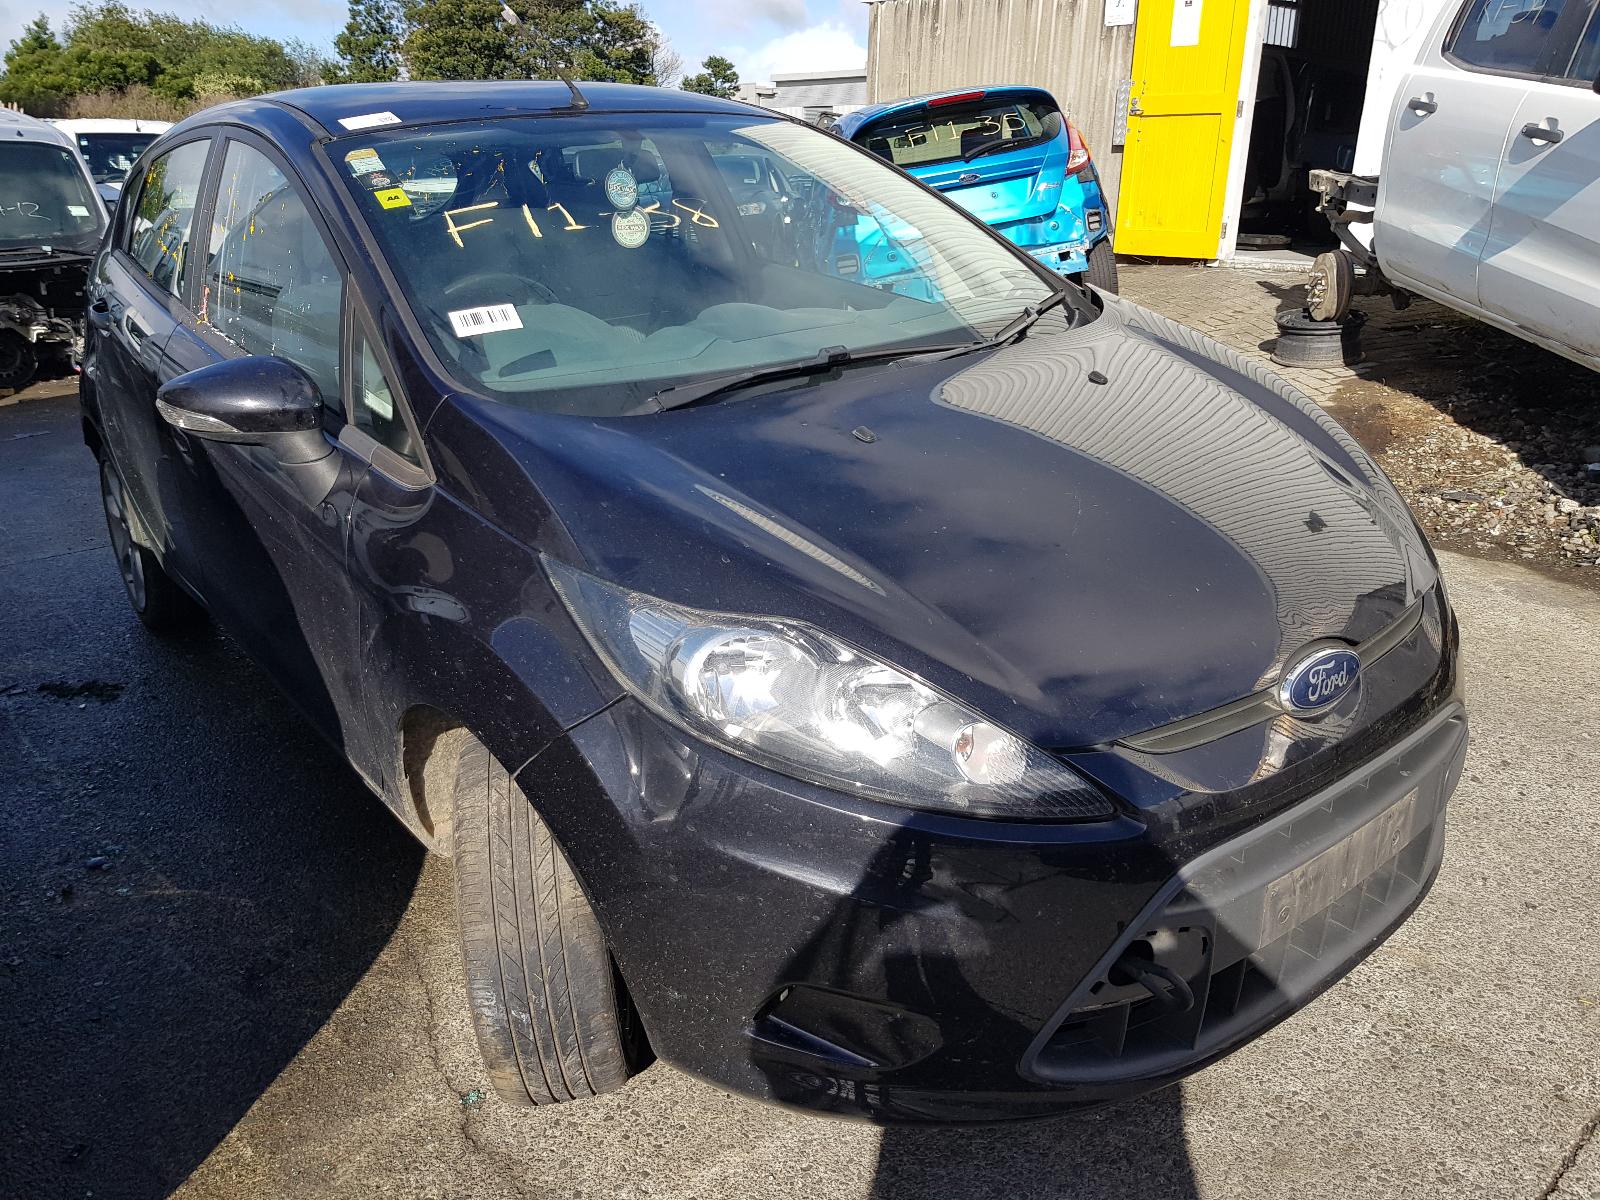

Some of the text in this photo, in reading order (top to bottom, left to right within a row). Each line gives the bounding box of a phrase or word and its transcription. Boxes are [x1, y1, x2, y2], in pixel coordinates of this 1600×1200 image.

[904, 112, 1026, 148] F11-35
[386, 194, 400, 202] AA
[1308, 659, 1349, 702] Ford
